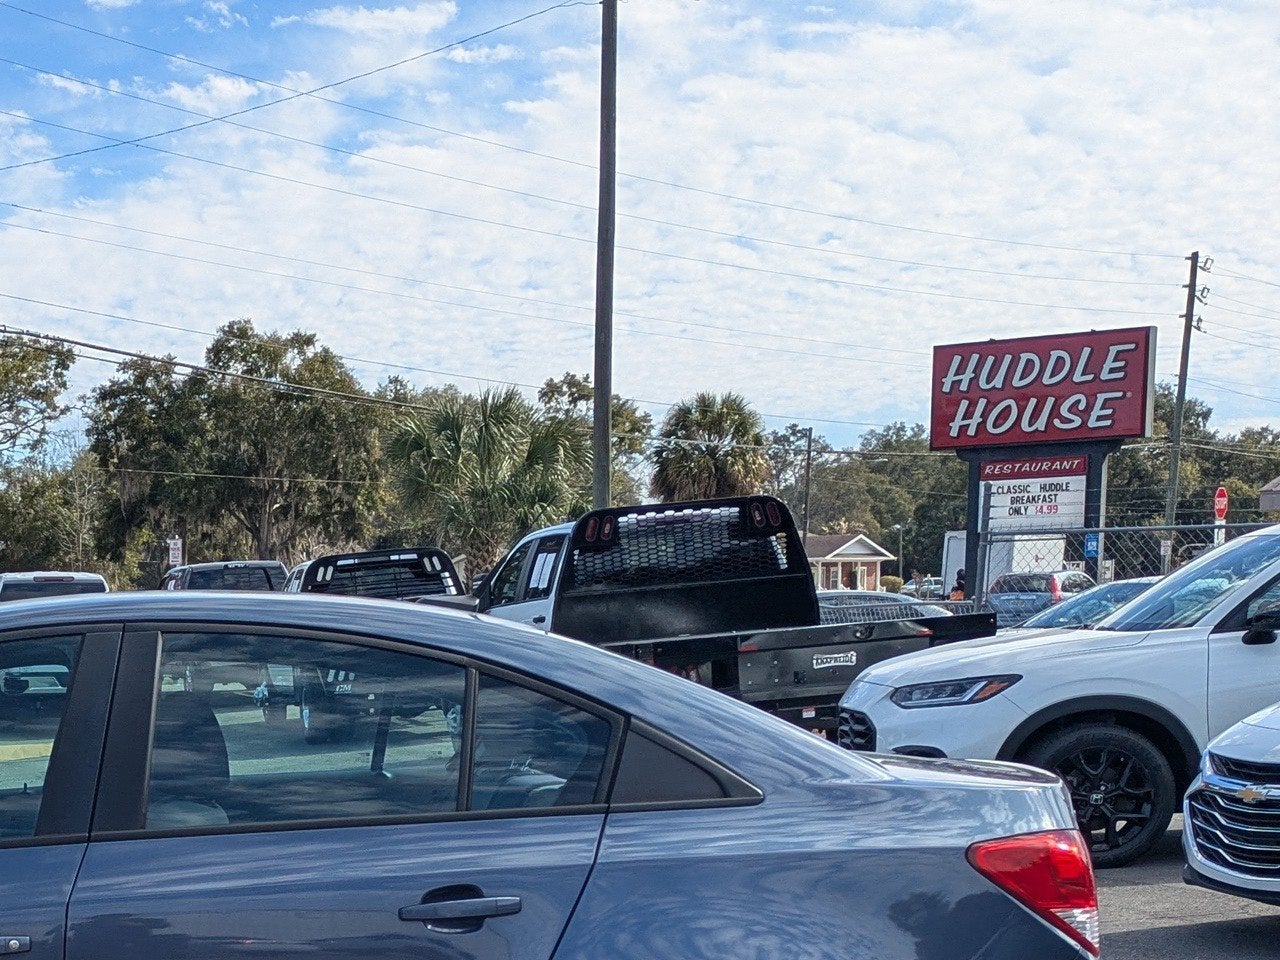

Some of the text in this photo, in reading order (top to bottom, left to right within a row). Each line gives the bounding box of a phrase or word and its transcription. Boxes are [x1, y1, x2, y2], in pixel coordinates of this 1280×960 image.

[941, 344, 1136, 393] HUDDLE
[949, 391, 1123, 437] HOUSE
[984, 459, 1081, 475] RESTAURANT
[996, 482, 1071, 495] CLASSIC HUDDLE
[1010, 494, 1059, 505] BREAKFAST
[1008, 505, 1059, 516] ONLY $4.99
